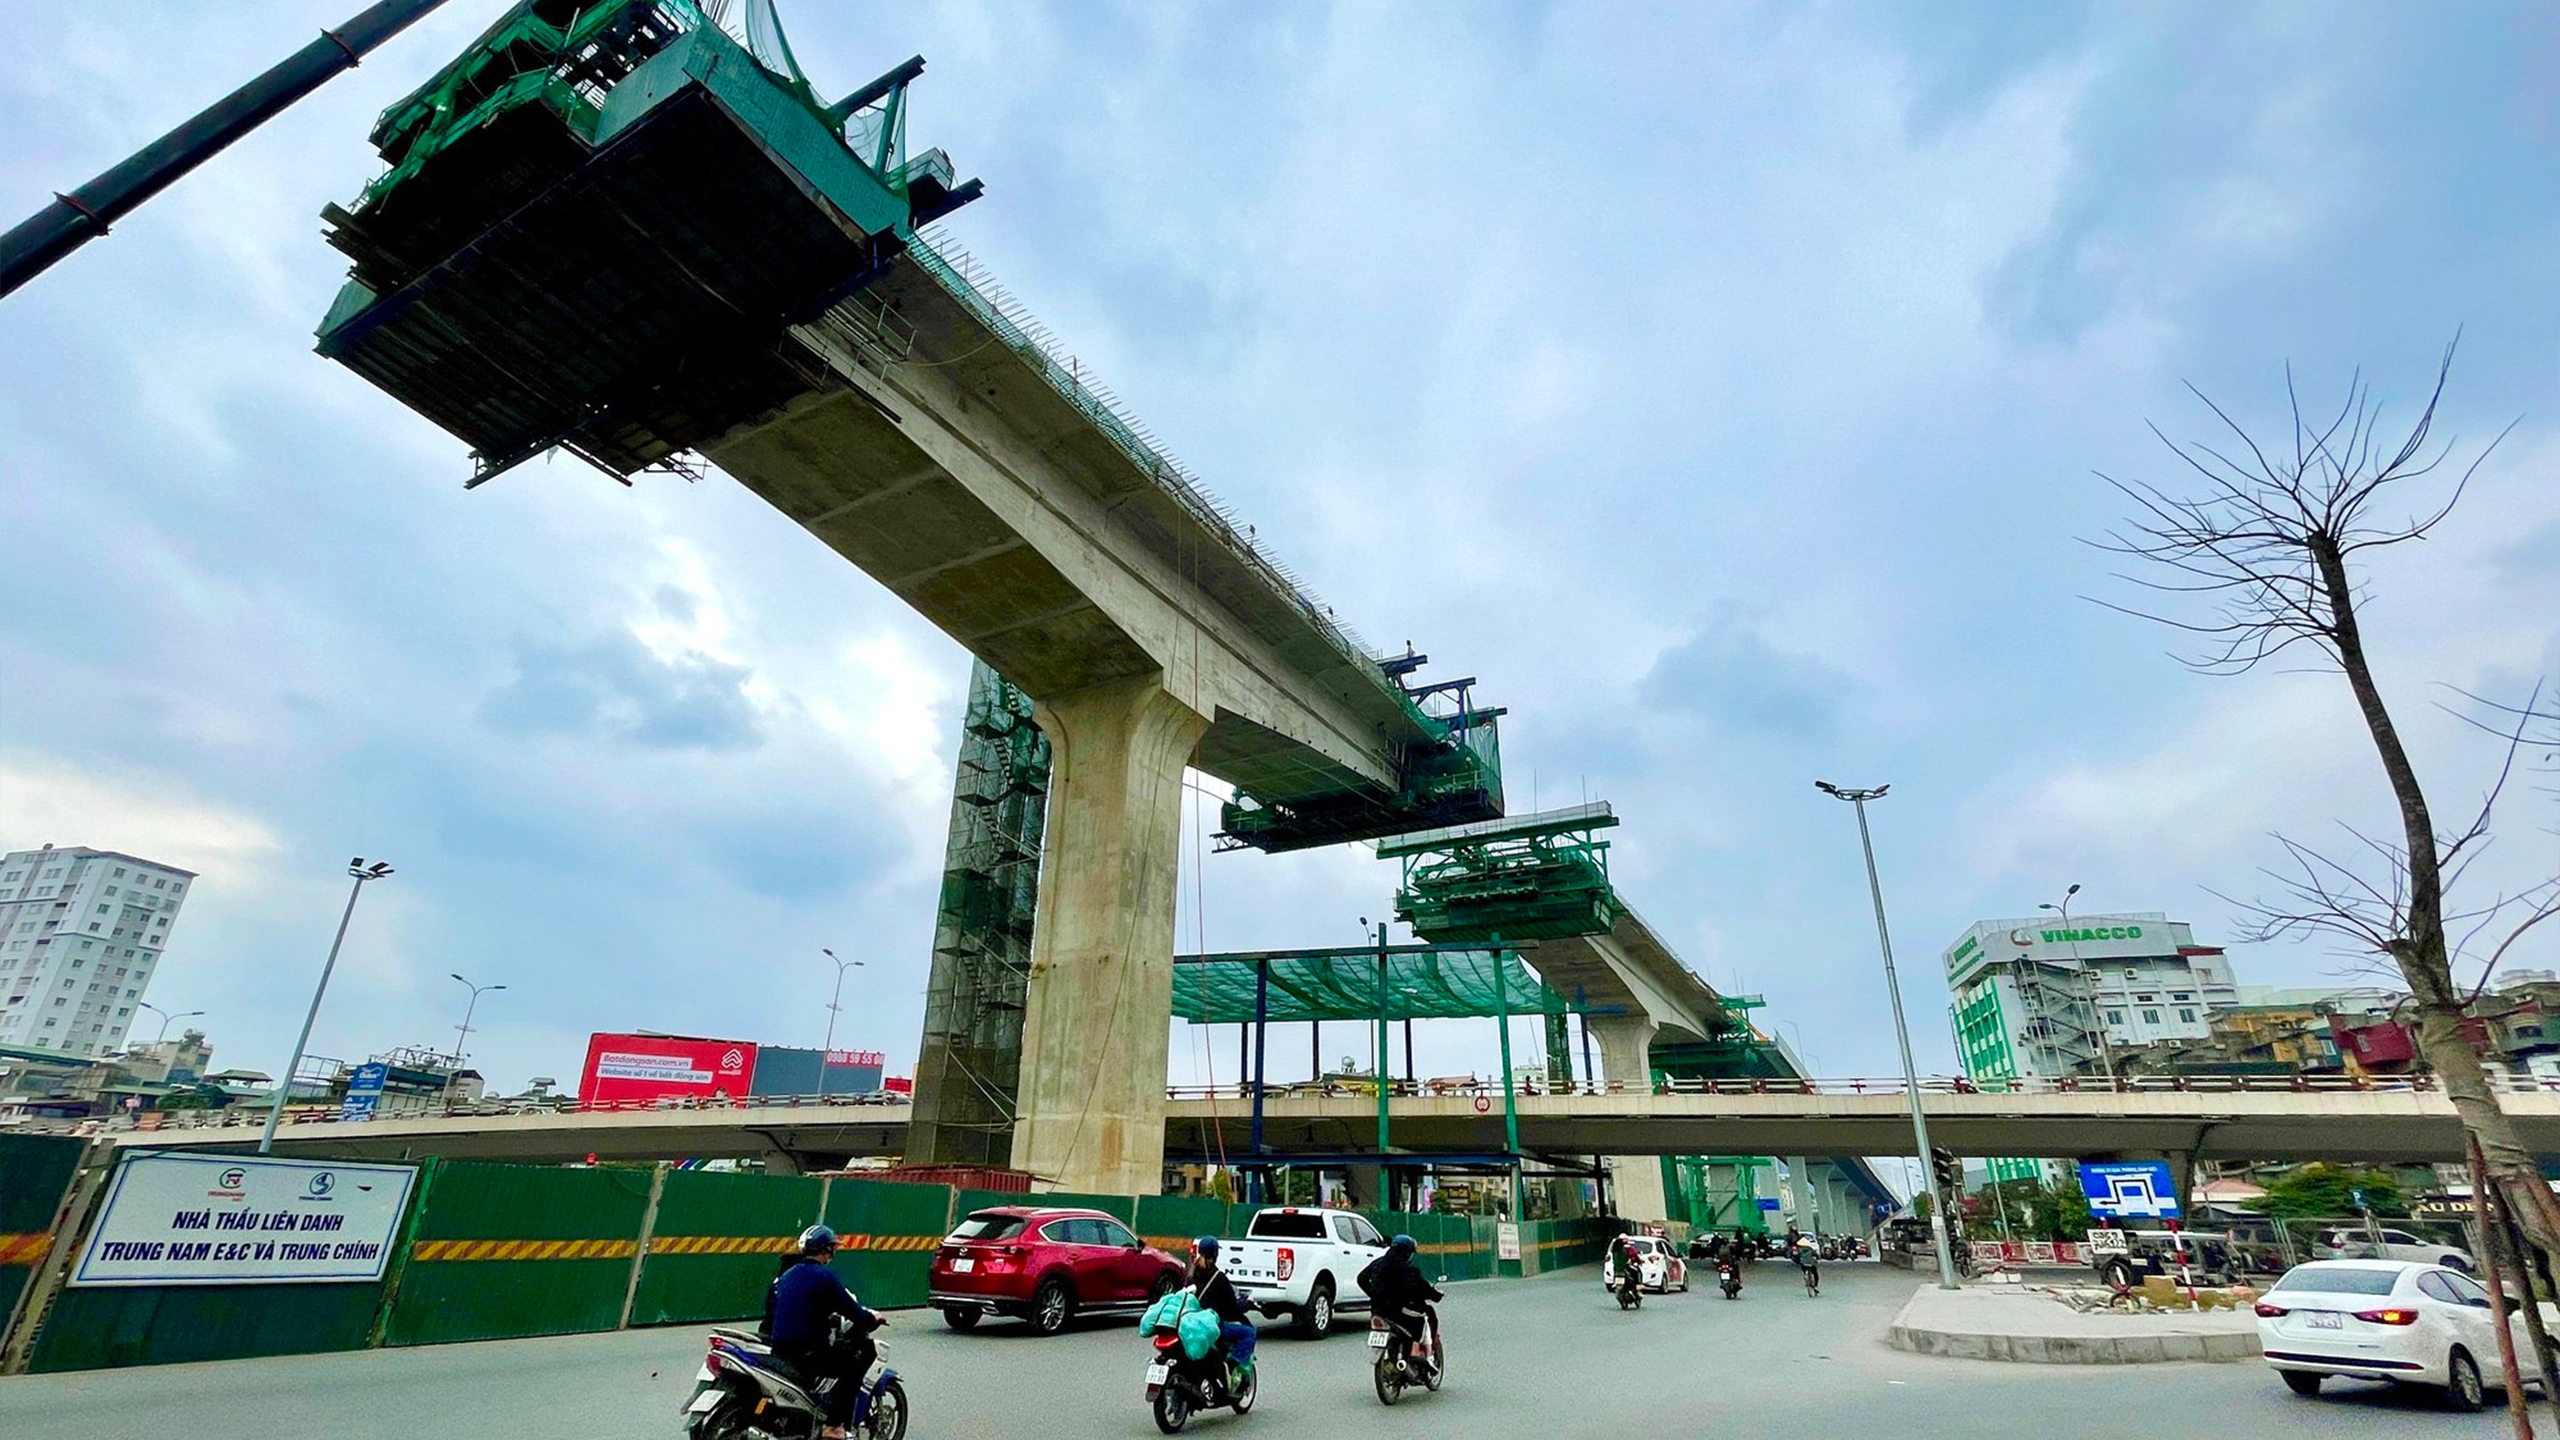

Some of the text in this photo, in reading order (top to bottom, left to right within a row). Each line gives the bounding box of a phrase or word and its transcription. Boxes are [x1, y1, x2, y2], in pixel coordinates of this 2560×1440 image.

[2040, 927, 2142, 943] VINACCO
[603, 1054, 689, 1067] Batdongsan.com.vn
[601, 1068, 631, 1076] Website
[260, 1210, 299, 1231] LIÊN
[300, 1214, 344, 1231] DANH
[100, 1242, 164, 1261] TRUNG
[166, 1242, 212, 1261] NAM
[212, 1242, 251, 1261] E&C
[279, 1243, 331, 1261] TRUNG
[333, 1239, 380, 1260] CHÍNH
[1225, 1269, 1275, 1277] NGER
